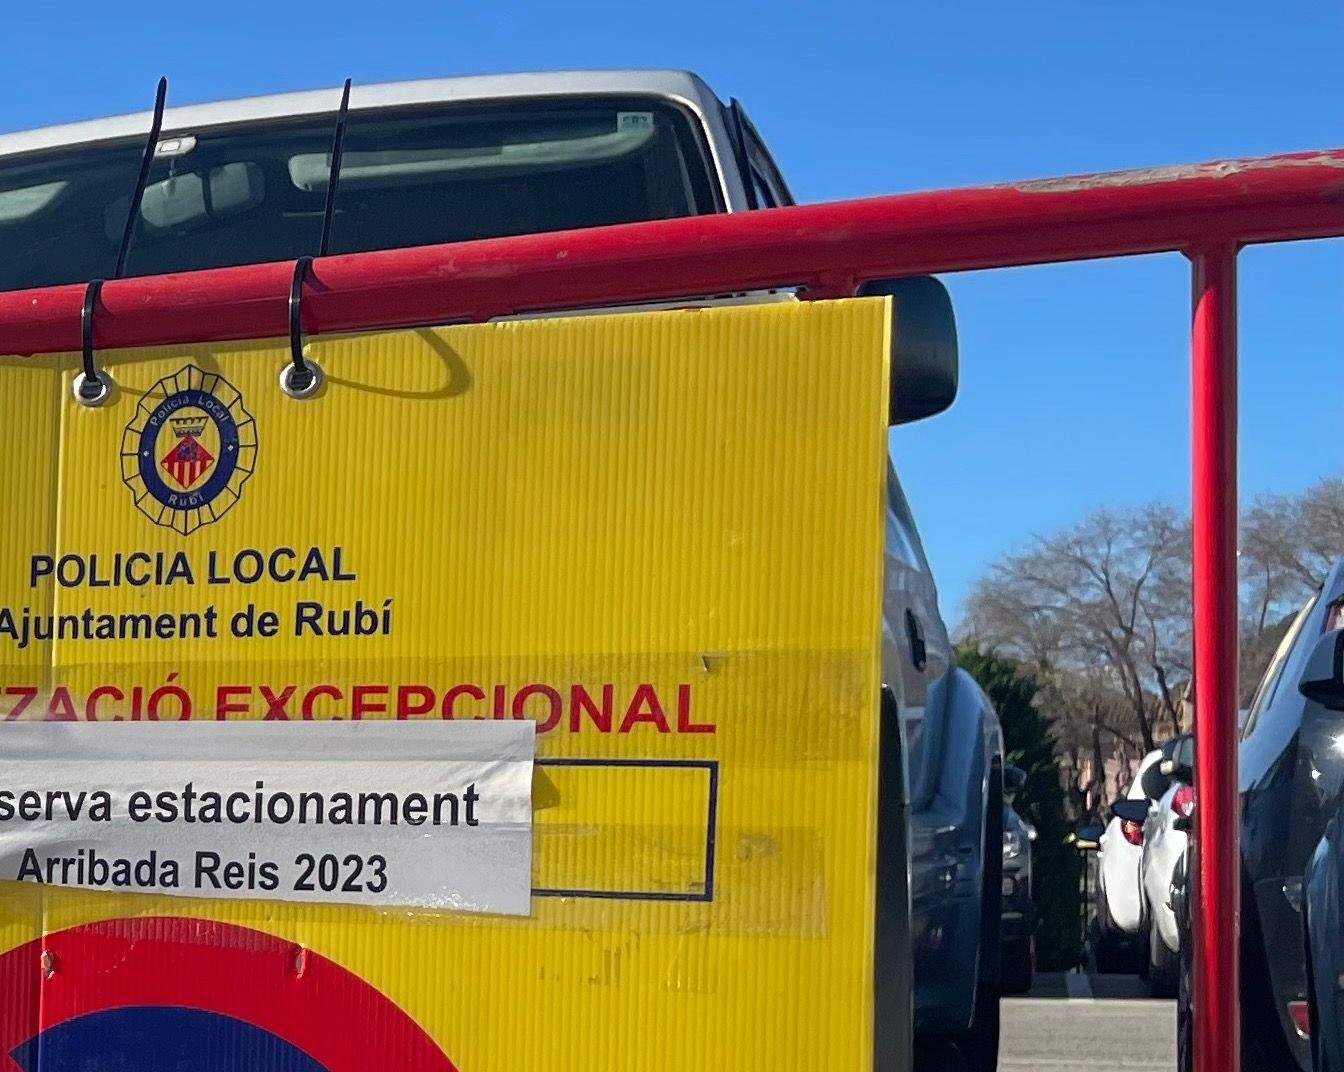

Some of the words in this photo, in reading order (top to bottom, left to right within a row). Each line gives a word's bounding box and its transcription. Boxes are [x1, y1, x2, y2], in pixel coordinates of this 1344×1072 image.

[198, 394, 230, 421] Local
[29, 550, 194, 588] POLICIA
[208, 546, 357, 584] LOCAL
[230, 603, 279, 637] de
[295, 598, 394, 637] Rubí
[215, 683, 717, 734] EXCEPCIONAL
[127, 780, 481, 827] estacionament
[16, 847, 180, 888] Arribada
[193, 850, 280, 891] Reis
[292, 853, 389, 894] 2023
